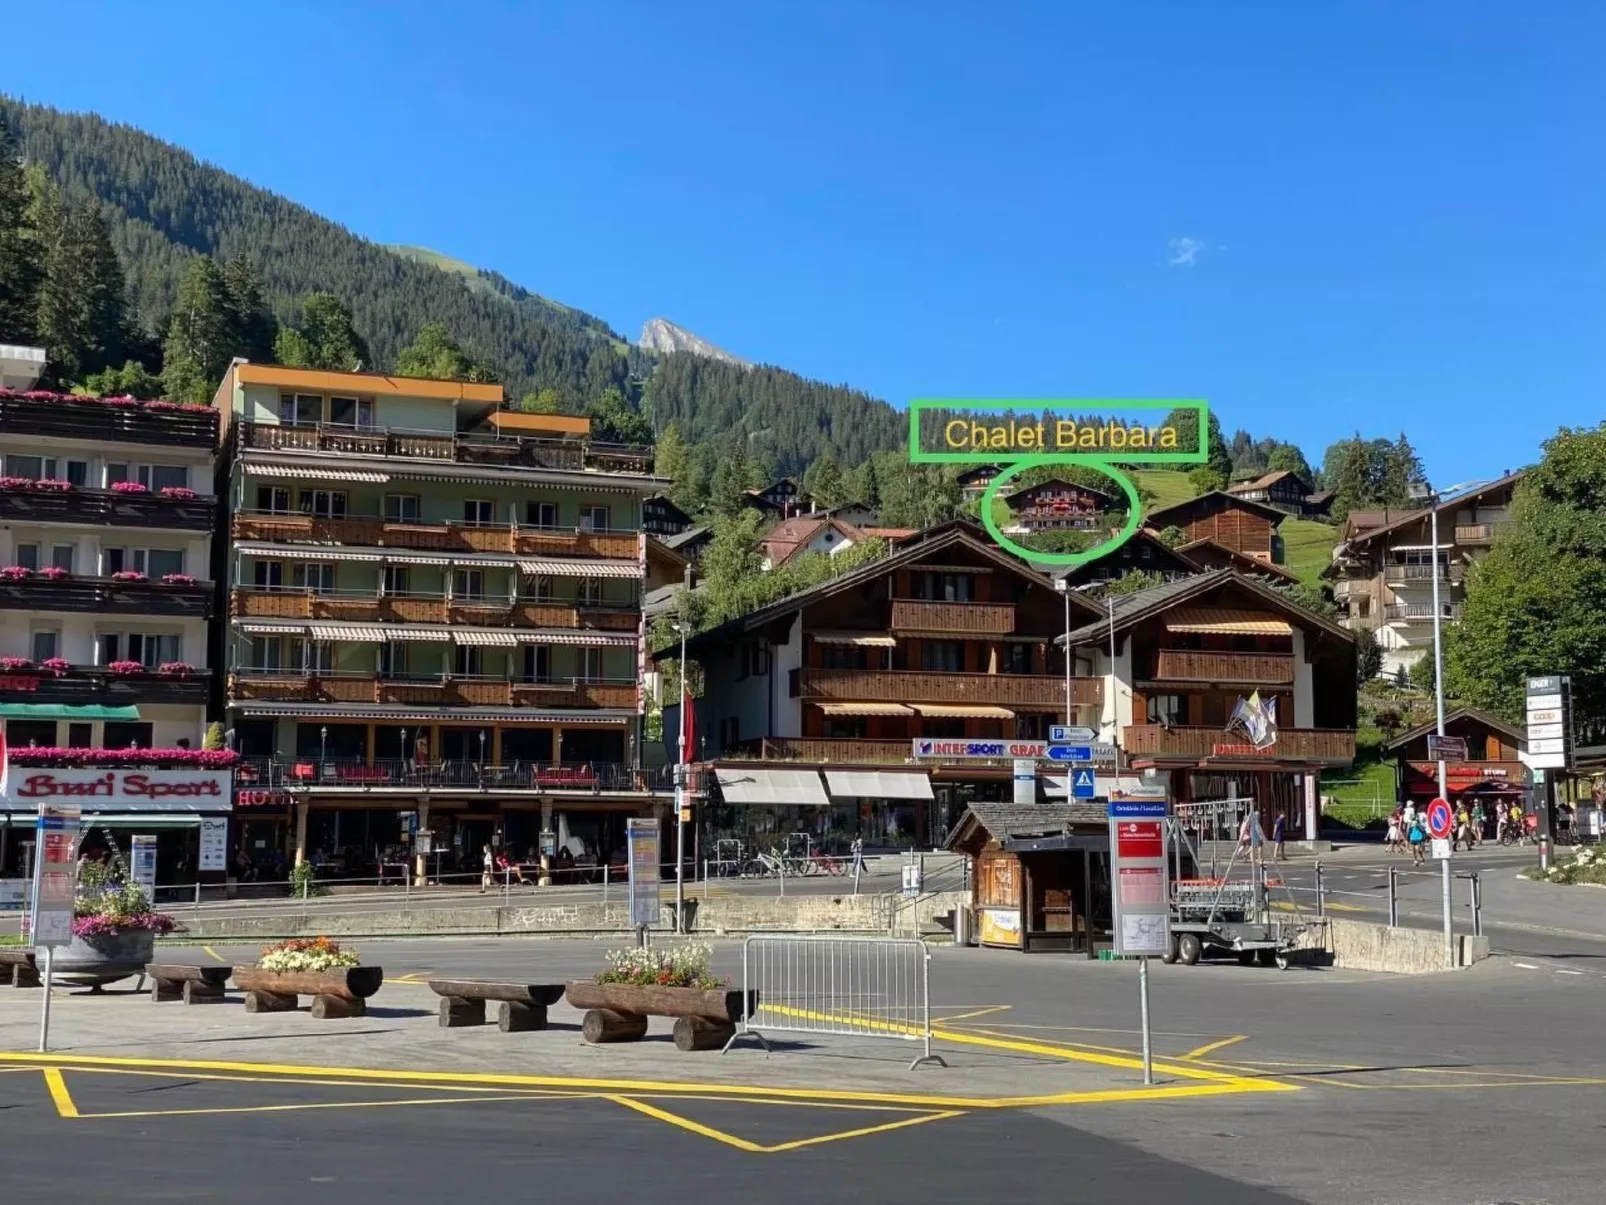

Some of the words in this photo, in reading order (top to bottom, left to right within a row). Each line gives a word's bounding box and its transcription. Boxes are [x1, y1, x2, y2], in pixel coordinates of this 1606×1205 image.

[933, 743, 1003, 757] INTERSPORT
[17, 773, 115, 797] Buri
[123, 774, 222, 799] Sport
